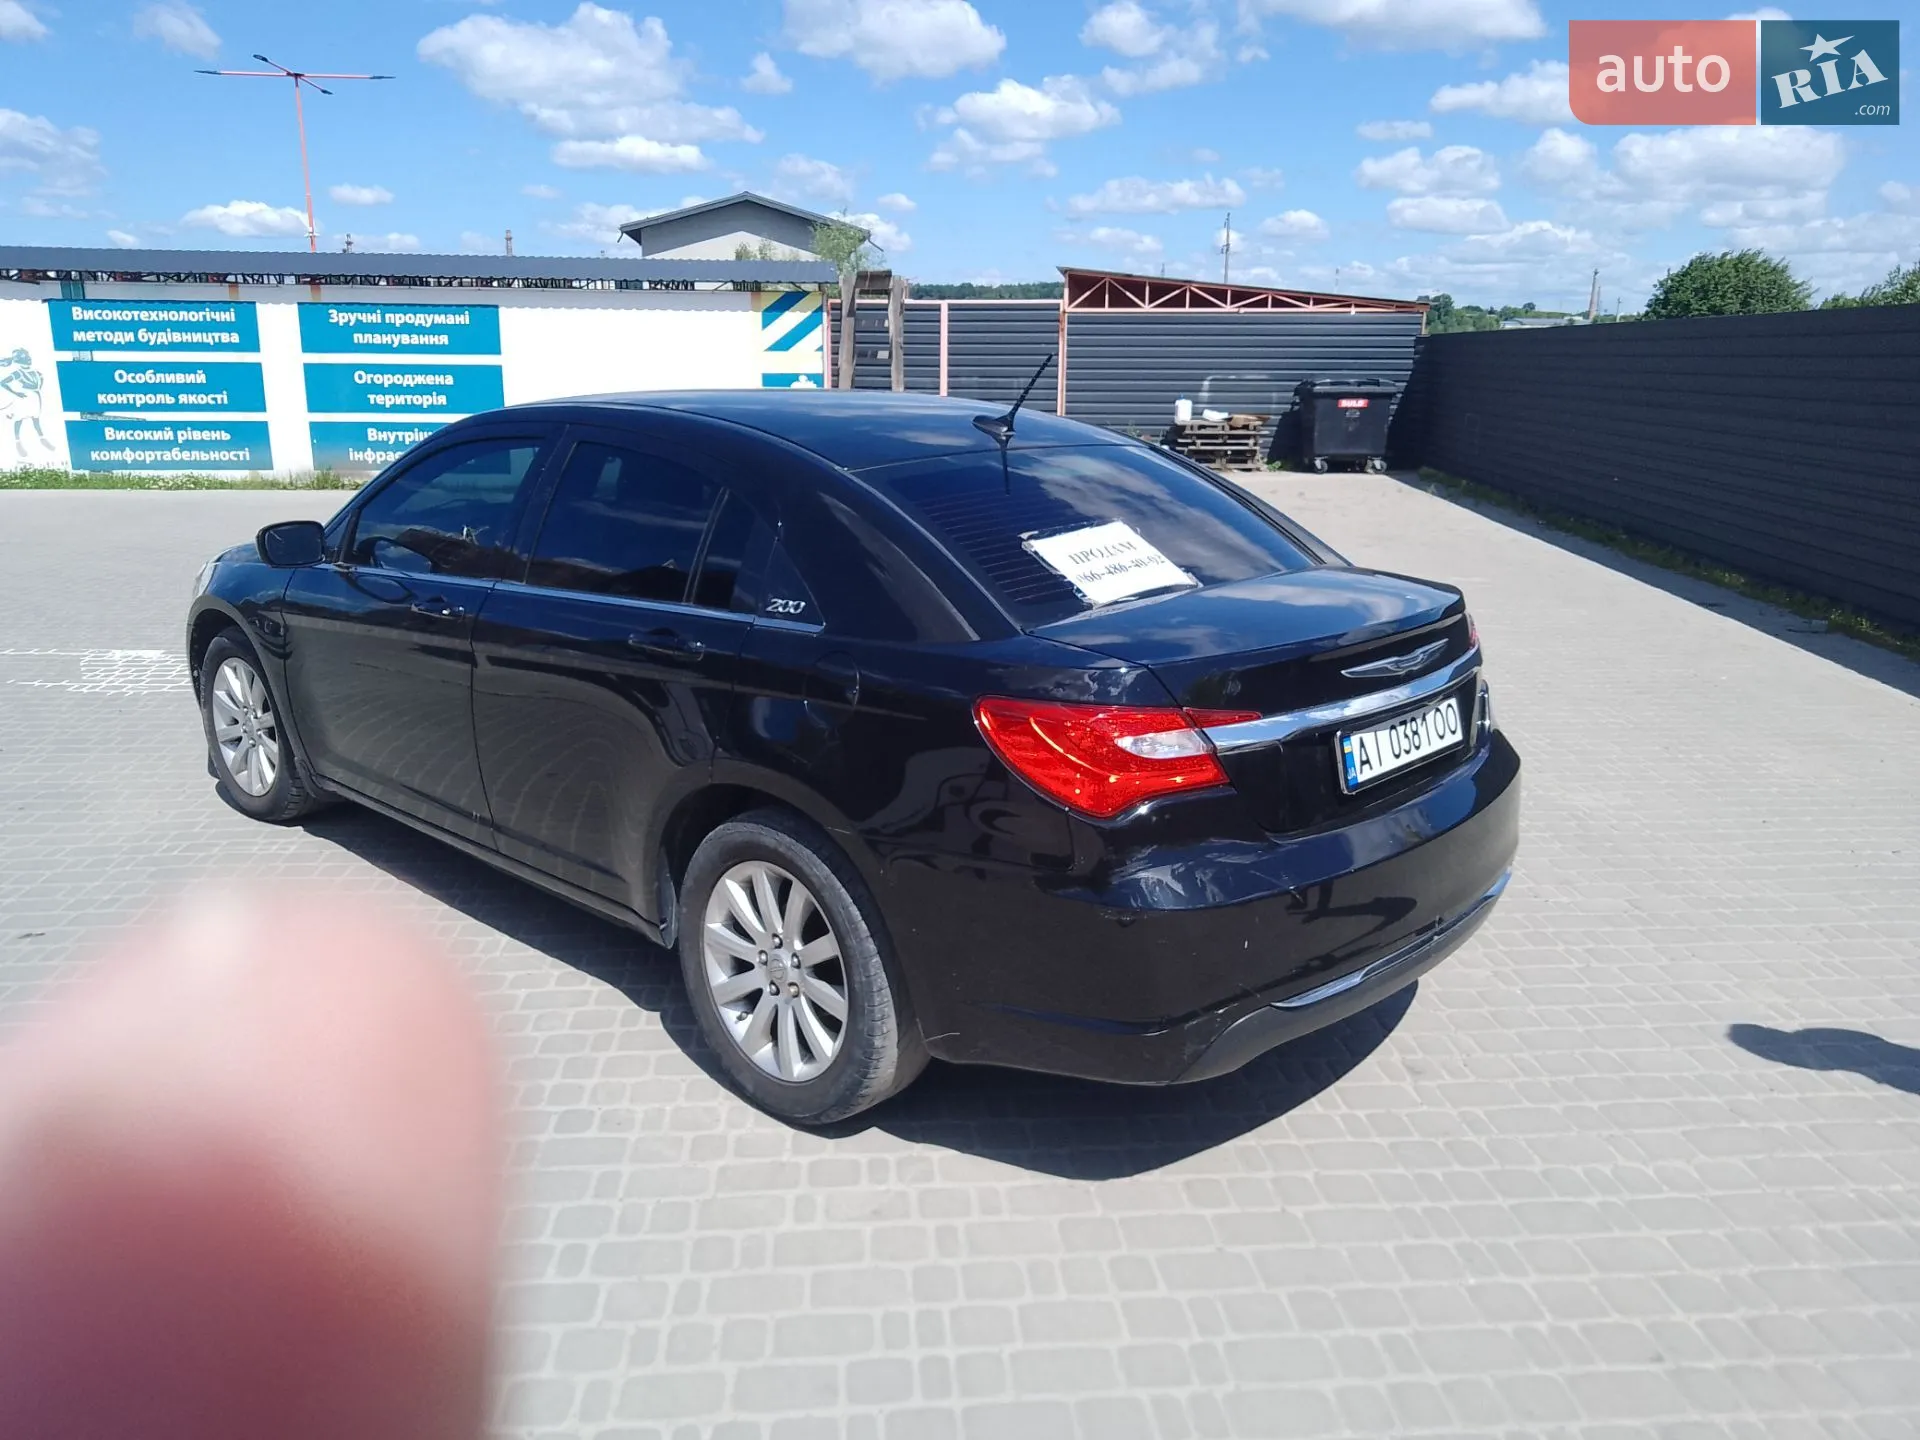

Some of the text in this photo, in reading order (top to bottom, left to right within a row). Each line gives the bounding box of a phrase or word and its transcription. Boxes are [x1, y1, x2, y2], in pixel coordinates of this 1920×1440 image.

[71, 306, 236, 322] Високотехнологічні
[328, 309, 470, 327] Зручні продумані
[73, 328, 240, 345] методи будівництва
[353, 332, 449, 348] планування
[114, 369, 206, 384] Особливий
[354, 370, 454, 387] Огороджена
[97, 390, 228, 407] контроль якості
[367, 391, 448, 408] територія
[104, 426, 231, 444] Високий рівень
[90, 447, 250, 463] комфортабельності
[766, 598, 806, 614] 200
[1389, 712, 1432, 759] 0381
